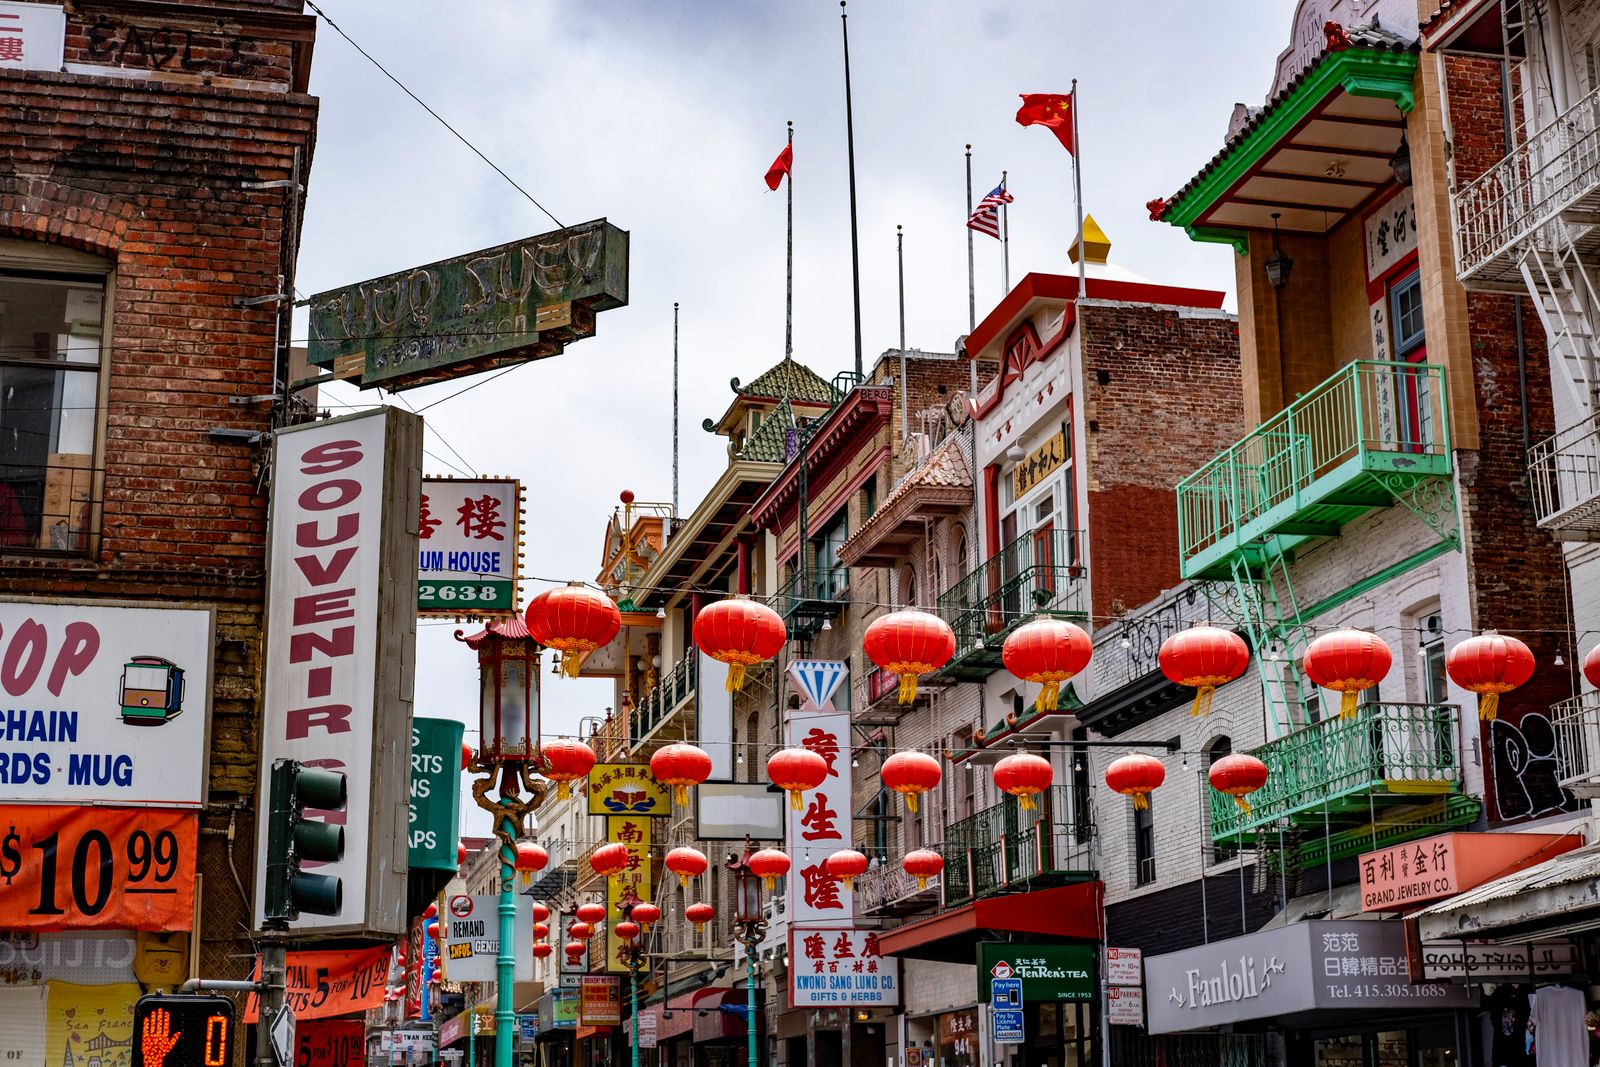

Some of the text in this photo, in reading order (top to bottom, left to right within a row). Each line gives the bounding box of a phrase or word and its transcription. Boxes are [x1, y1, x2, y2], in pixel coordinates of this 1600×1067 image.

[1302, 14, 1322, 48] LUM
[420, 551, 501, 573] UM HOUSE
[286, 440, 364, 740] SOUVENIR
[419, 585, 497, 601] 2638
[0, 617, 100, 697] OP
[68, 754, 133, 787] MUG
[1365, 877, 1452, 907] GRAND JEWELRY CO.
[453, 921, 485, 938] REMAND
[1108, 949, 1140, 960] NO STOPPING
[797, 975, 896, 990] KWONG SANG LUNG CO.
[1066, 970, 1088, 978] TEA
[1186, 955, 1259, 1009] Fanloli
[311, 968, 330, 1008] 5
[331, 980, 348, 994] FOR
[811, 992, 882, 1001] GIFTS & HERBS
[1109, 988, 1141, 999] NO PARKING
[1327, 984, 1447, 998] Tel. 415.305.1685
[205, 1016, 227, 1066] 0
[954, 1038, 969, 1056] 941
[7, 1051, 22, 1060] OF
